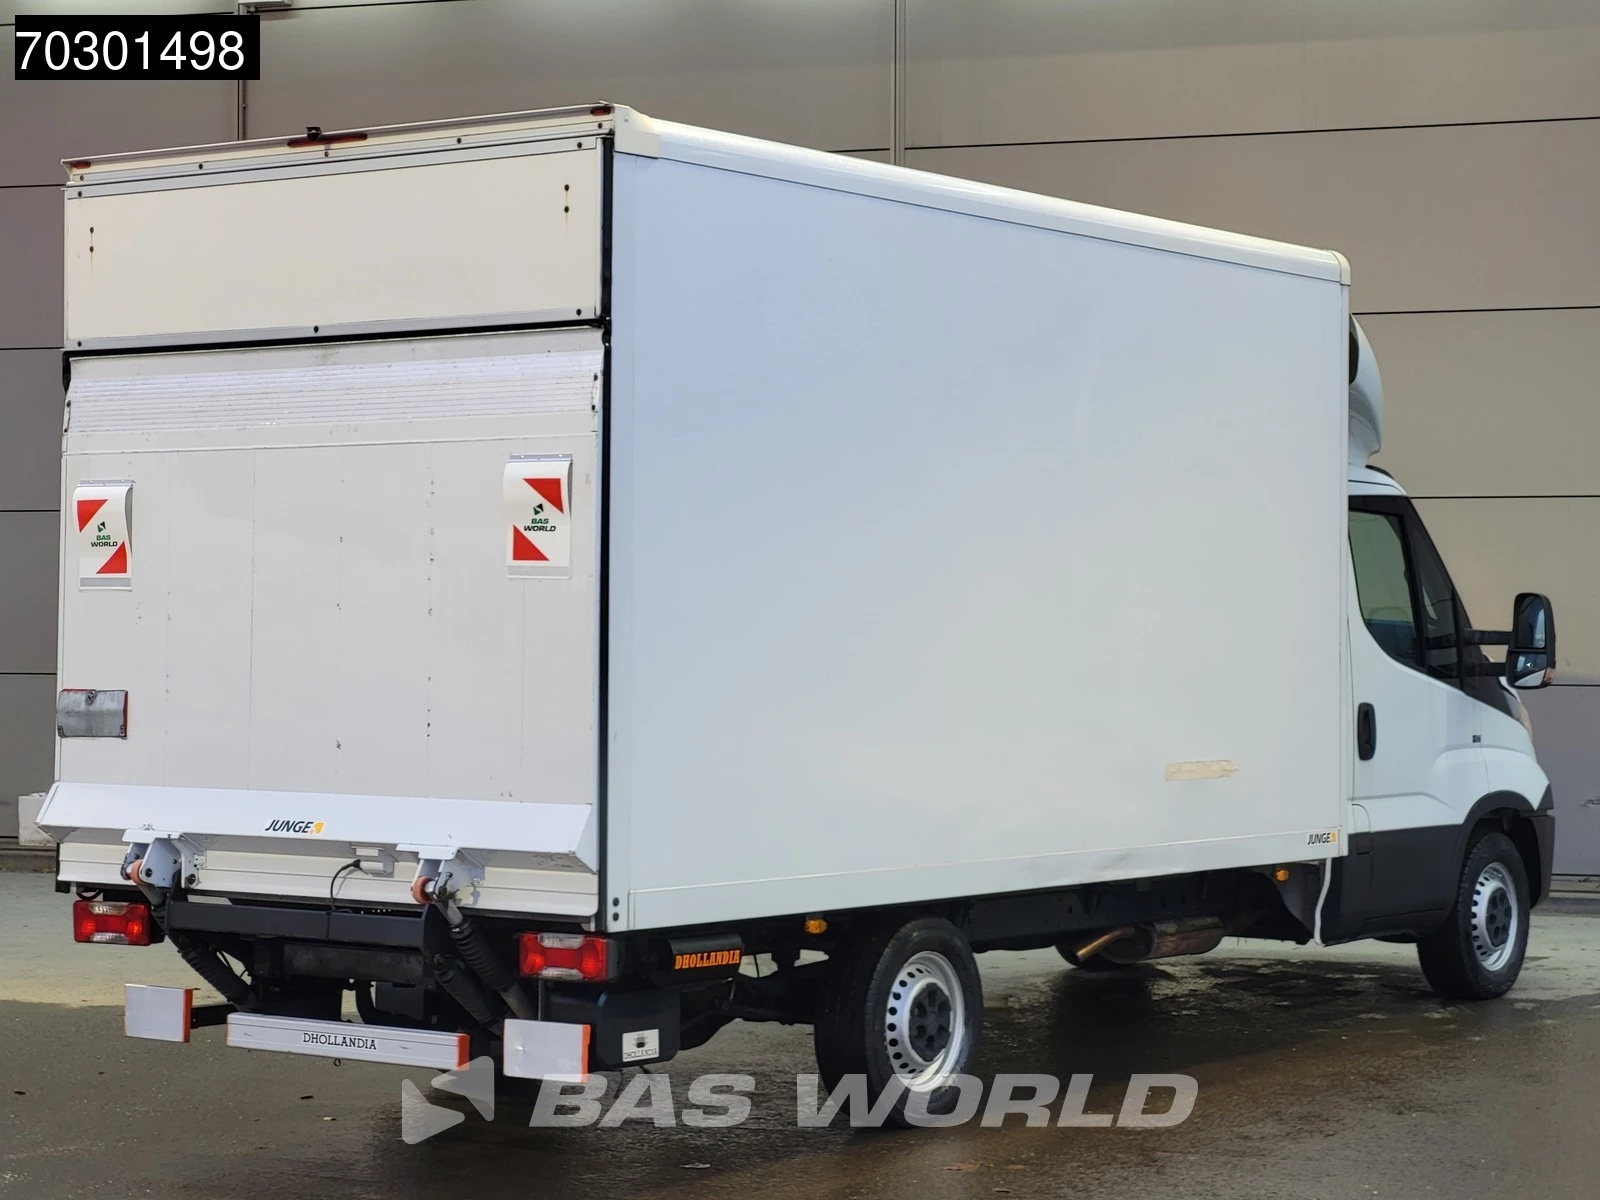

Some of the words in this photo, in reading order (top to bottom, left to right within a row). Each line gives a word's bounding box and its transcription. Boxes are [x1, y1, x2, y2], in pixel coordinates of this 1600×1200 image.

[531, 517, 549, 525] BAS
[264, 819, 314, 834] JUNGE
[1307, 832, 1331, 845] JUNGE
[674, 949, 741, 970] DHOLLANDIA
[302, 1032, 377, 1050] DHOLLANDIA
